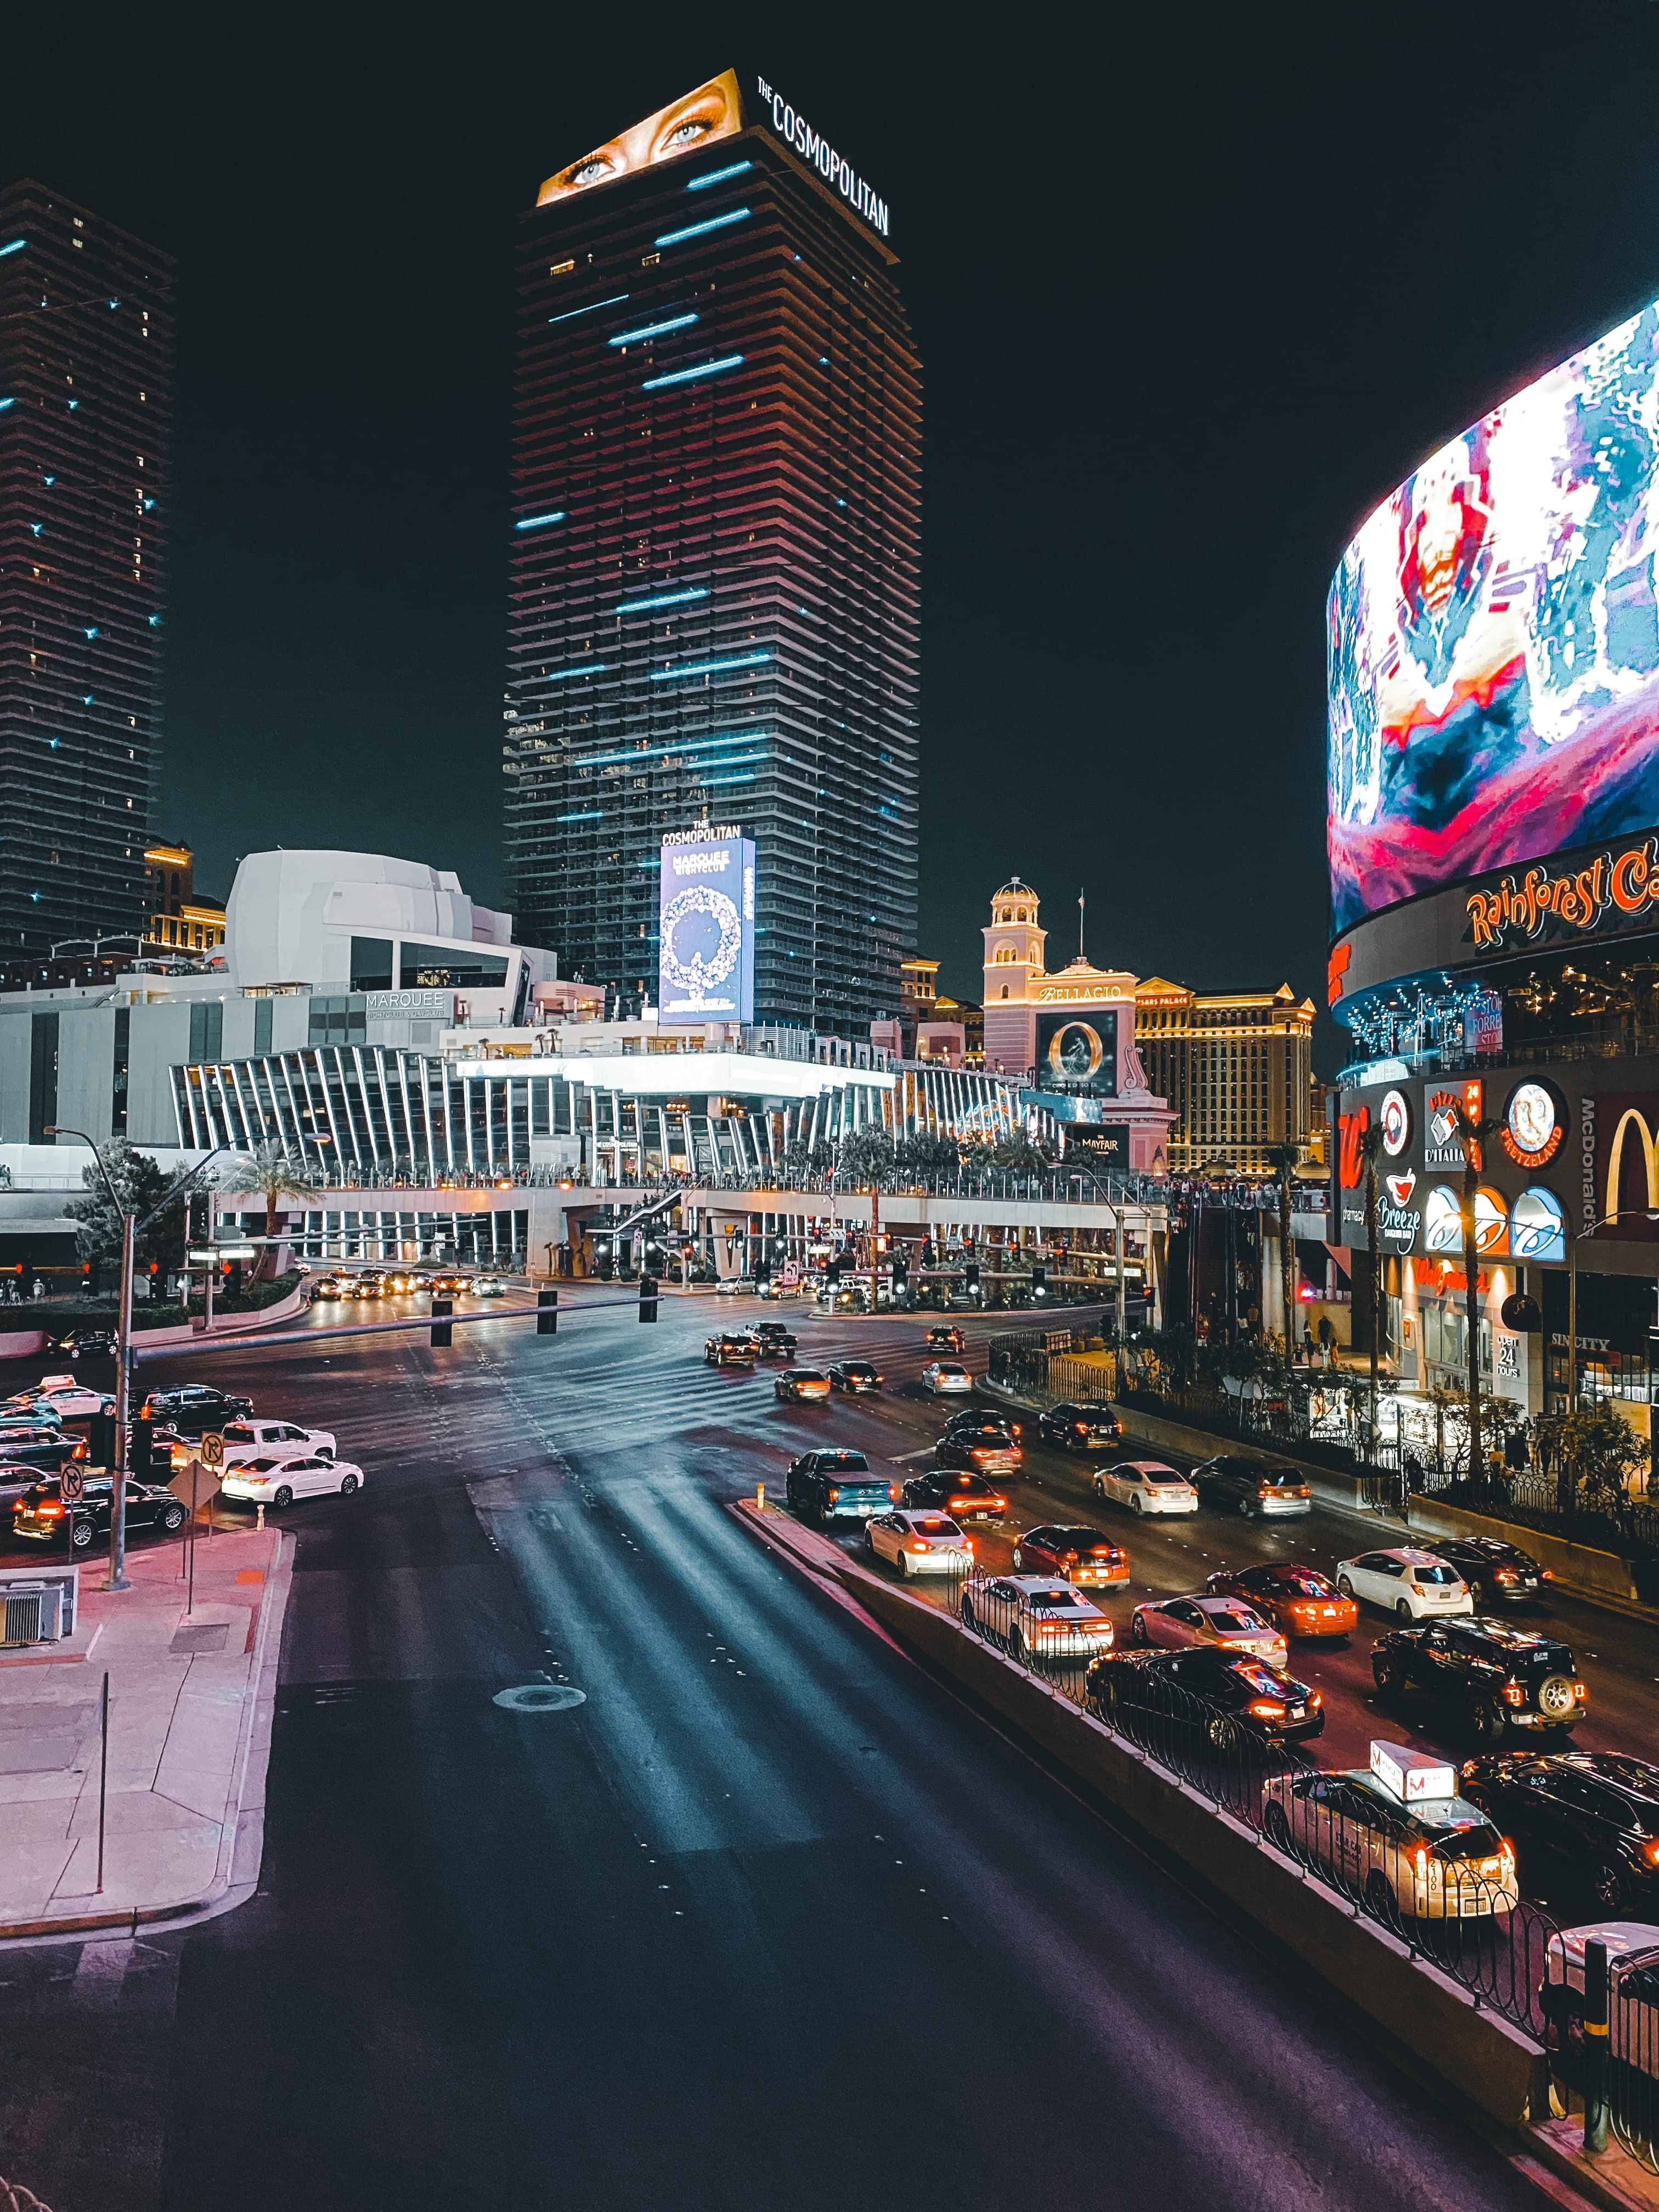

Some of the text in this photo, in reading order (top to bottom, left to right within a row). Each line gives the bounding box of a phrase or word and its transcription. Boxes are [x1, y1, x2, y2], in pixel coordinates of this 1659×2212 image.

[757, 75, 890, 236] THE COSMOPOLITAN
[692, 819, 709, 829] THE
[662, 825, 741, 847] COSMOPOLITAN
[673, 851, 730, 867] MARQUEE
[1466, 856, 1609, 946] Rainforest
[366, 992, 444, 1008] MARQUEE
[1035, 986, 1121, 1002] BELLAGIO
[367, 1011, 405, 1019] NIGHTCLUB
[412, 1009, 444, 1018] DAYCLUB
[1467, 1085, 1479, 1099] 24
[1082, 1138, 1119, 1151] MAYFAIR
[1502, 1126, 1562, 1167] PRETZELAND
[1425, 1148, 1465, 1163] D'ITALIA
[1582, 1098, 1596, 1237] McDonald's
[1342, 1207, 1365, 1226] pharmacy
[1378, 1195, 1420, 1255] Breeze
[1402, 1230, 1412, 1239] BAR
[1497, 1335, 1516, 1347] open
[1551, 1333, 1611, 1351] SIN CITY
[1499, 1347, 1514, 1366] 24
[1497, 1363, 1518, 1378] hours
